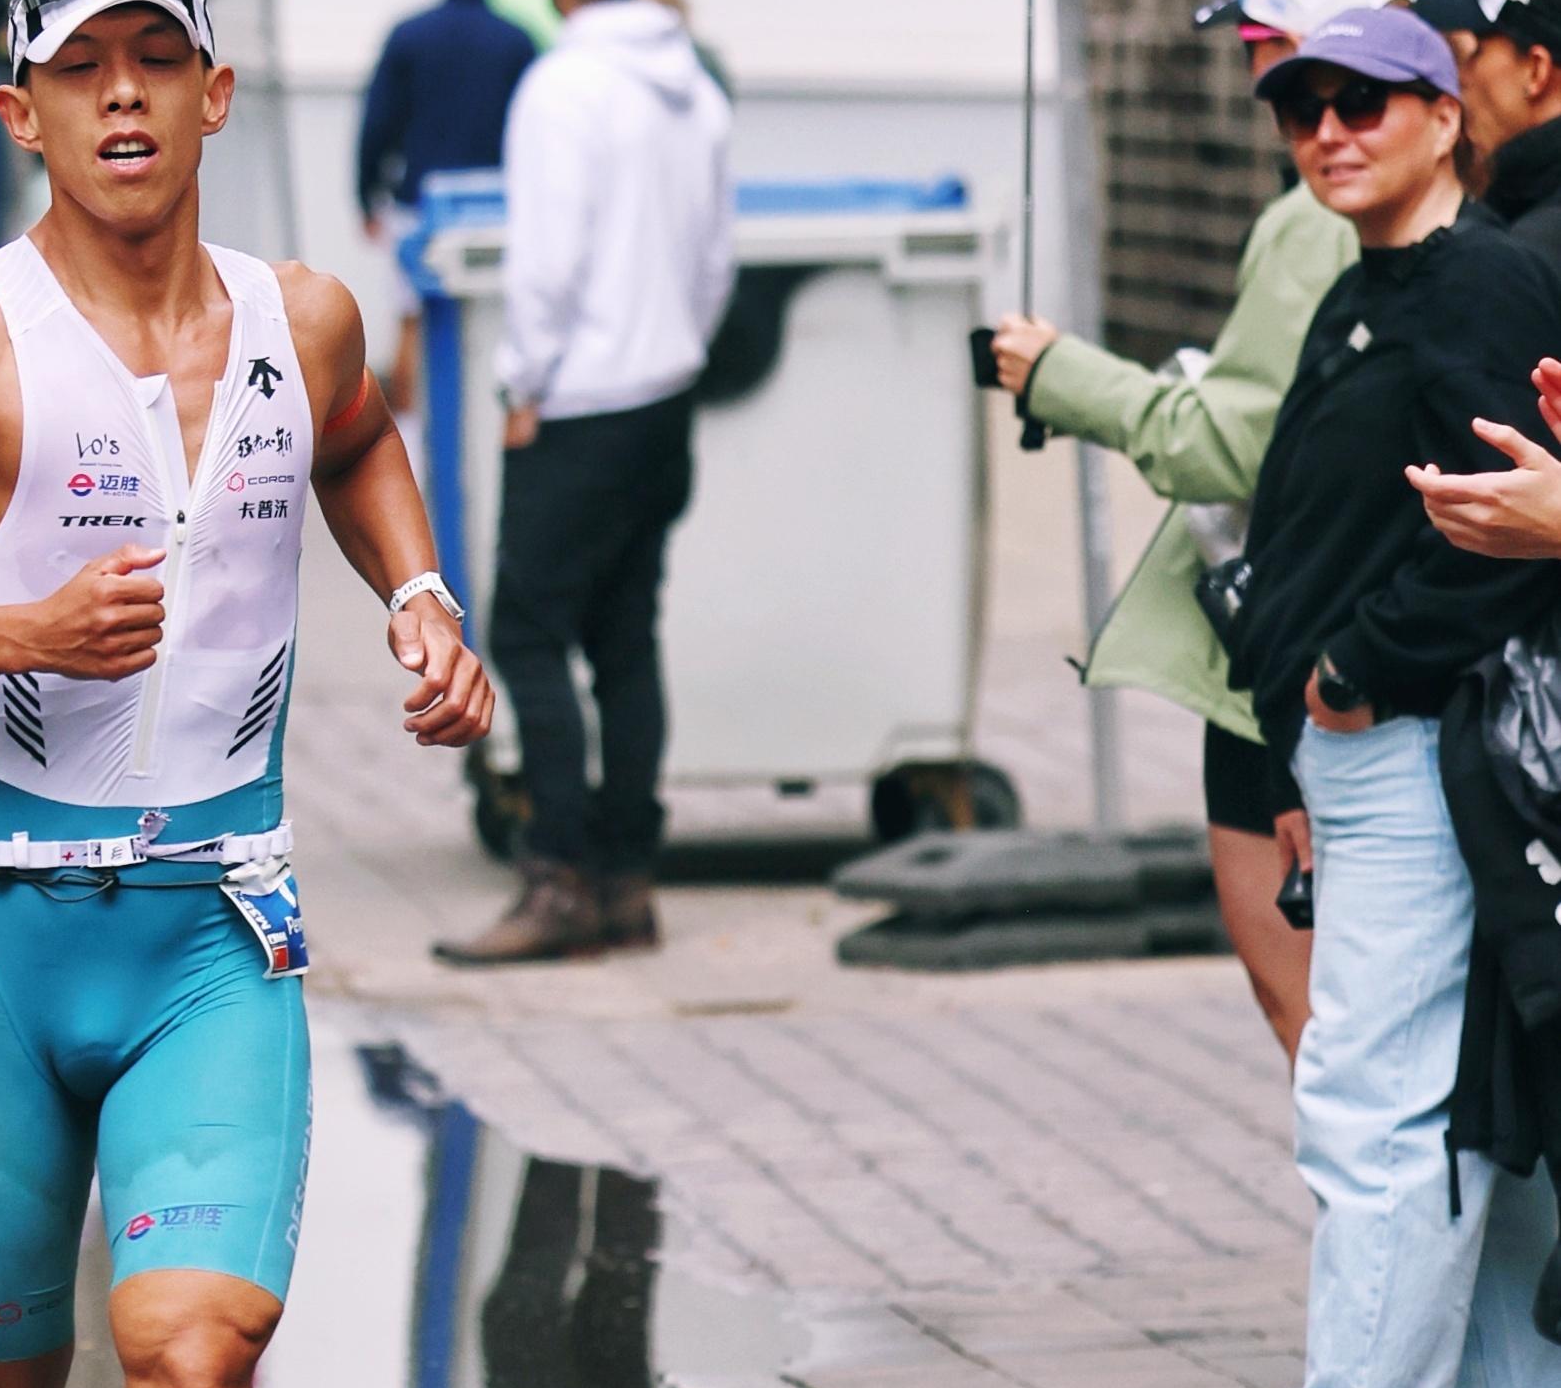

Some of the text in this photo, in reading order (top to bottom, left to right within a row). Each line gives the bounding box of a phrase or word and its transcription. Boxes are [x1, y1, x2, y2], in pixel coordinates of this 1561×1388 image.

[98, 474, 140, 492] 迈胜
[248, 475, 295, 485] COROS
[238, 499, 289, 520] 卡普沃
[58, 515, 148, 528] TREK
